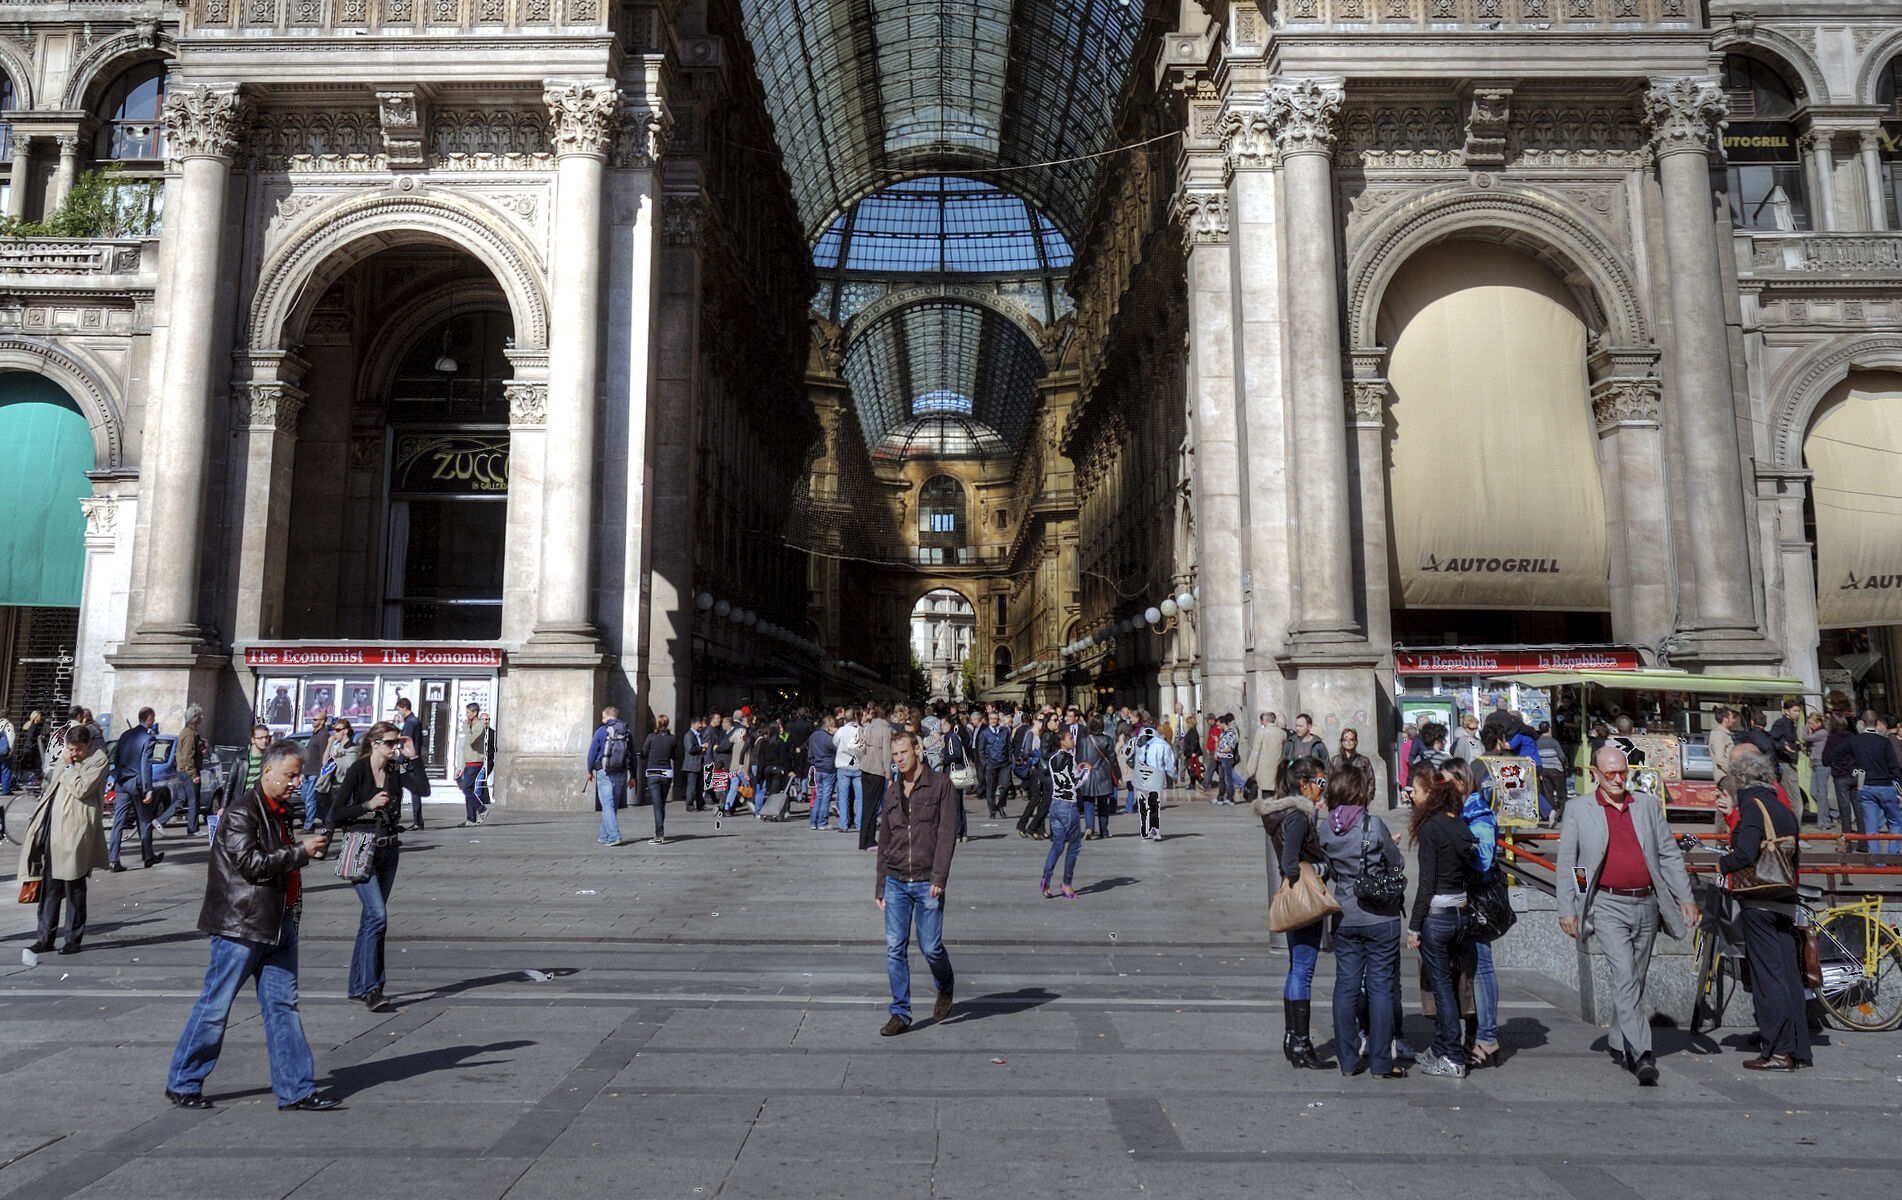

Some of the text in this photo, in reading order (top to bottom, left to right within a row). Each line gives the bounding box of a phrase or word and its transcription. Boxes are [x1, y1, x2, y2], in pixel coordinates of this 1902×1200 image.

[1722, 135, 1790, 148] UTOGRILL
[1444, 558, 1560, 573] AUTOGRILL
[248, 648, 364, 664] The Economist
[381, 648, 497, 664] The Economist
[1418, 655, 1498, 672] la Repubblica
[1538, 654, 1618, 671] la Repubblica
